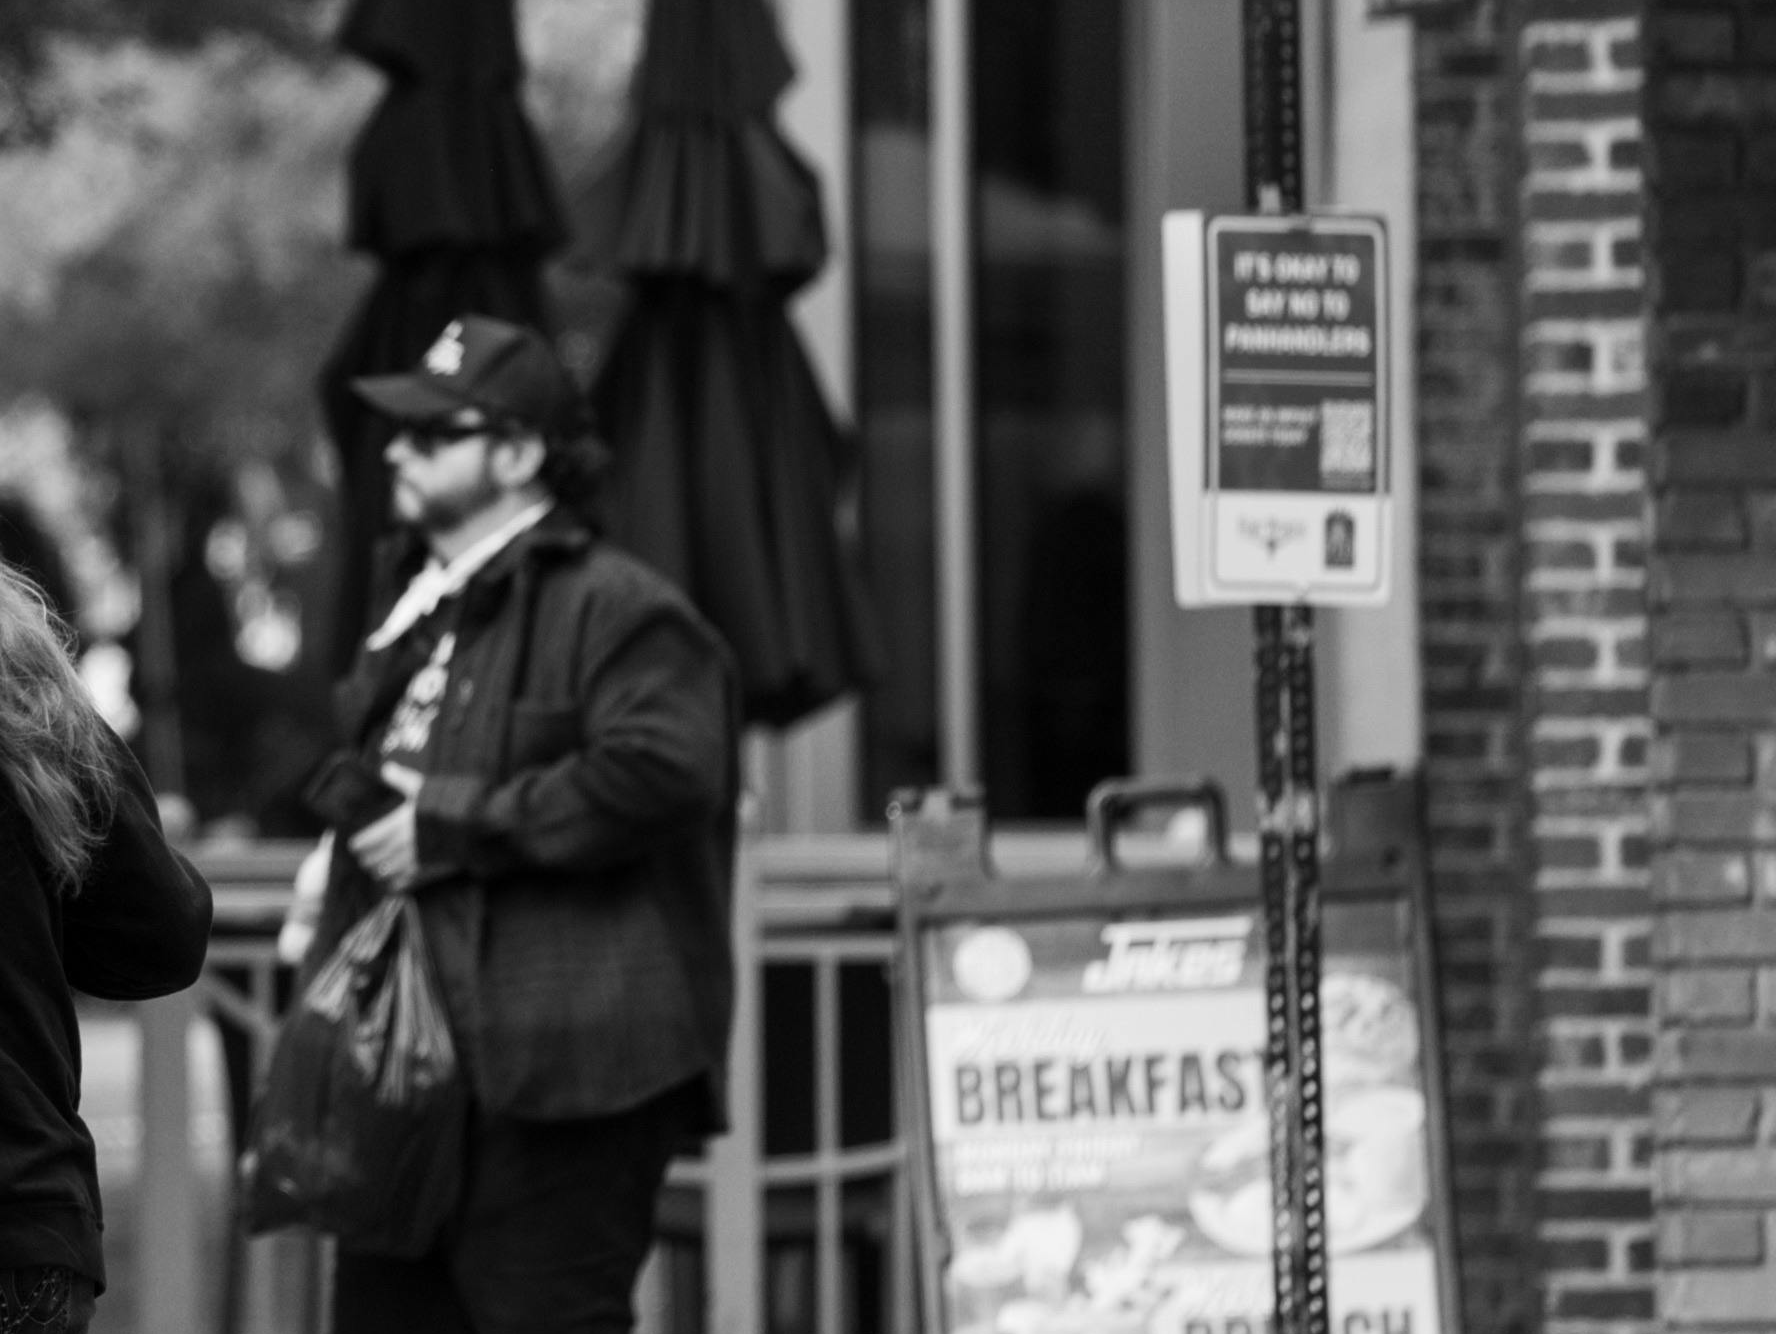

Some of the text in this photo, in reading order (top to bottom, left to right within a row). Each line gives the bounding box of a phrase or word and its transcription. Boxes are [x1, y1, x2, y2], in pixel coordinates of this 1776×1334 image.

[1332, 253, 1362, 286] TO
[1288, 288, 1322, 320] NO
[1322, 288, 1352, 322] TO
[1223, 321, 1373, 359] PANHANDLERS
